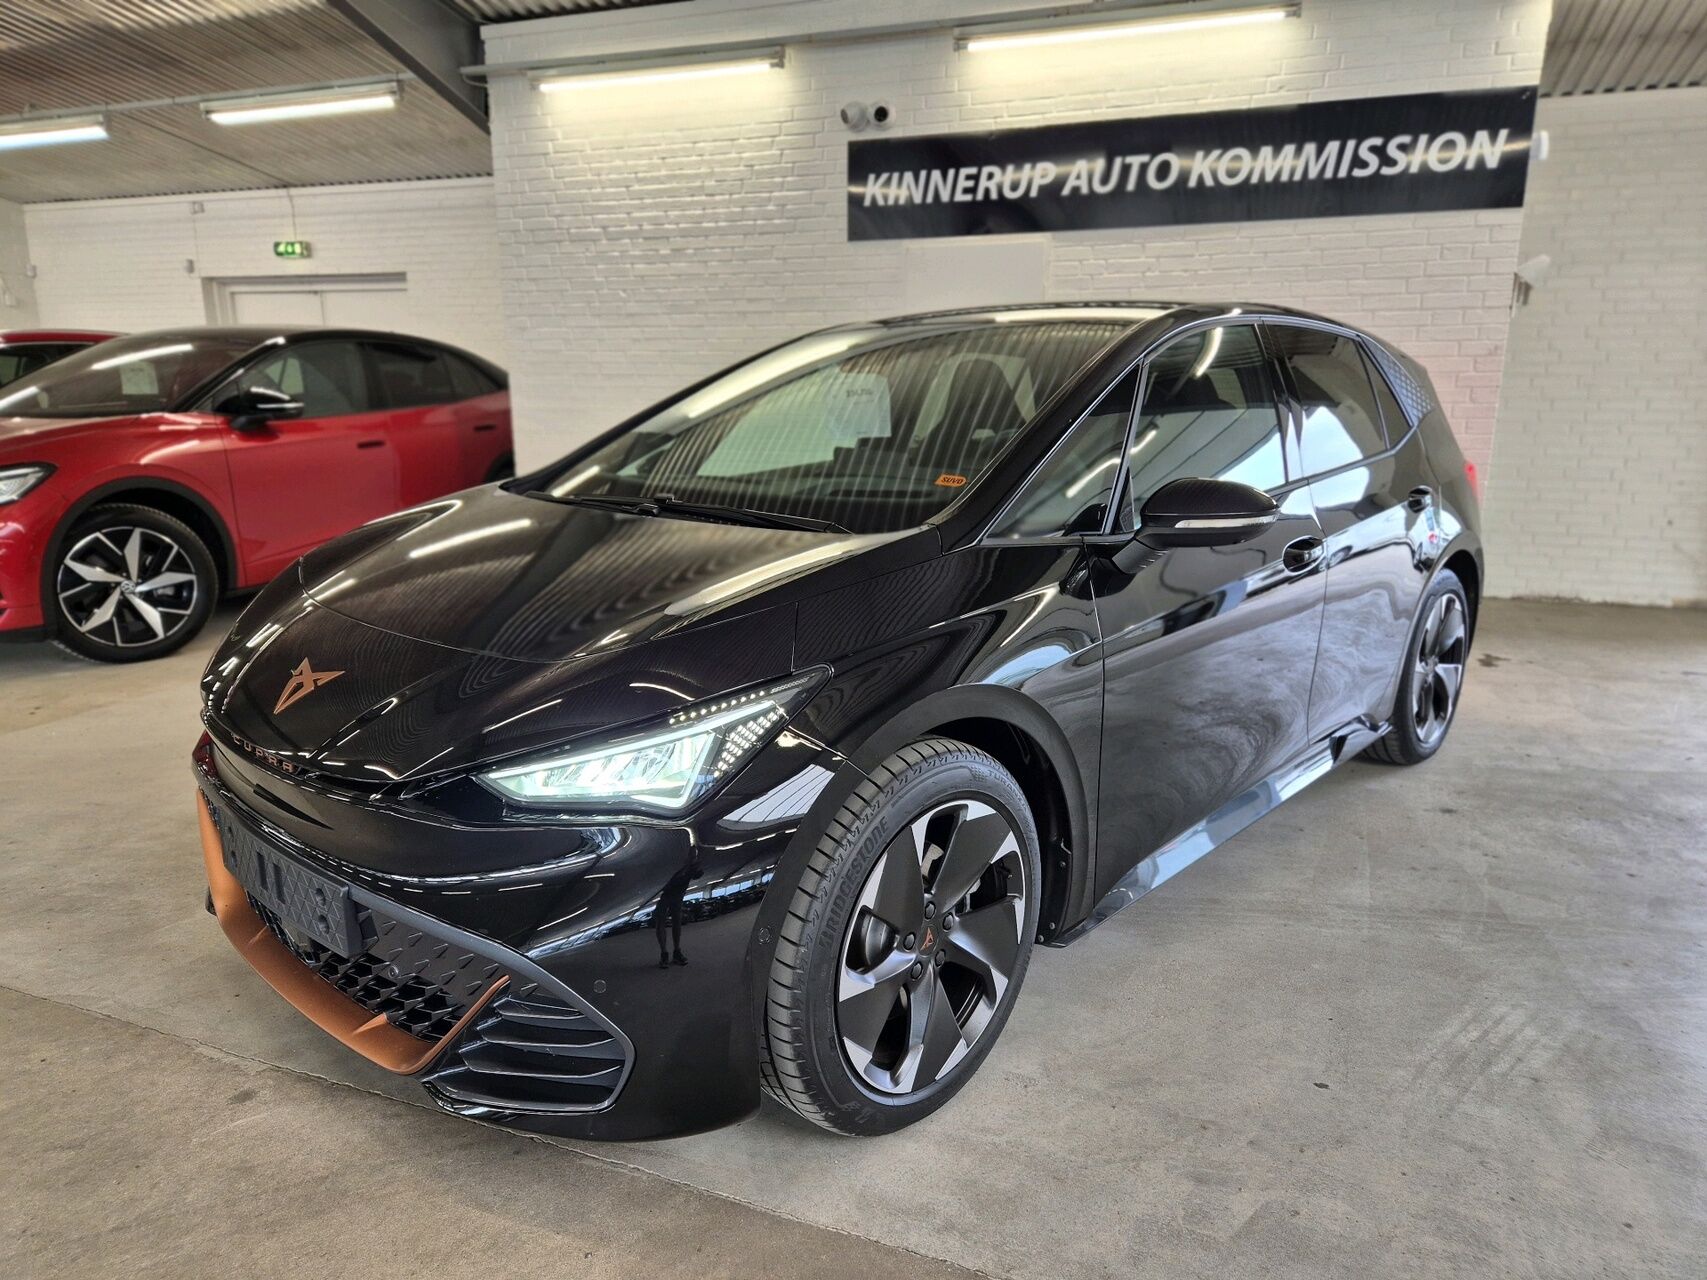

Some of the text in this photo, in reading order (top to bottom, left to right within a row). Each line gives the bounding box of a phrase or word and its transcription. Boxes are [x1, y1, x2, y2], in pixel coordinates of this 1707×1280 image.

[863, 128, 1510, 207] KINNERUP AUTO KOMMISSION
[232, 734, 295, 773] CUPRA
[819, 815, 889, 949] BRIDGESTONE
